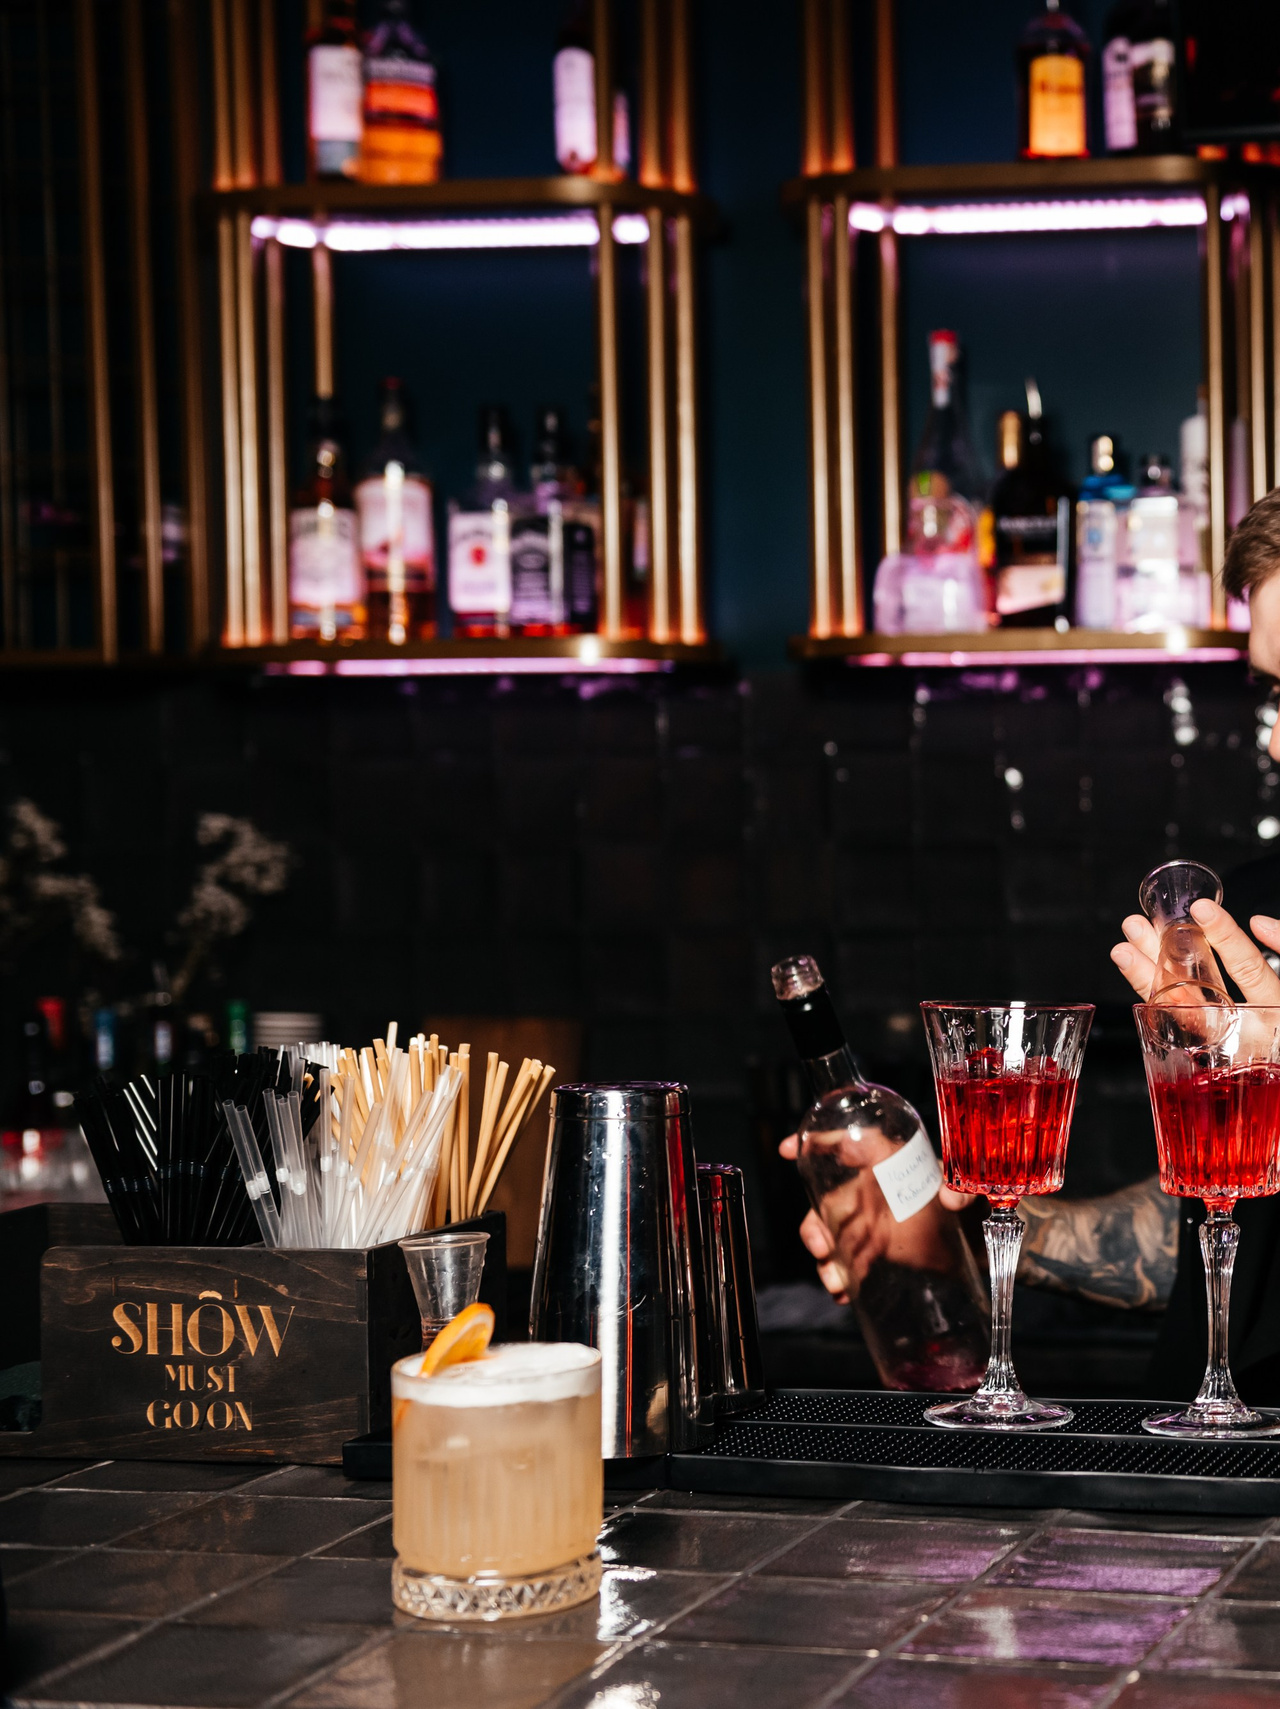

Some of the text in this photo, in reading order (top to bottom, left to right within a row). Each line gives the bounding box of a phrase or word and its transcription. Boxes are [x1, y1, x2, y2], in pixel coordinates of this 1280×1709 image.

[111, 1301, 296, 1357] SHOW
[165, 1364, 240, 1393] MUST
[146, 1399, 253, 1431] GO ON
